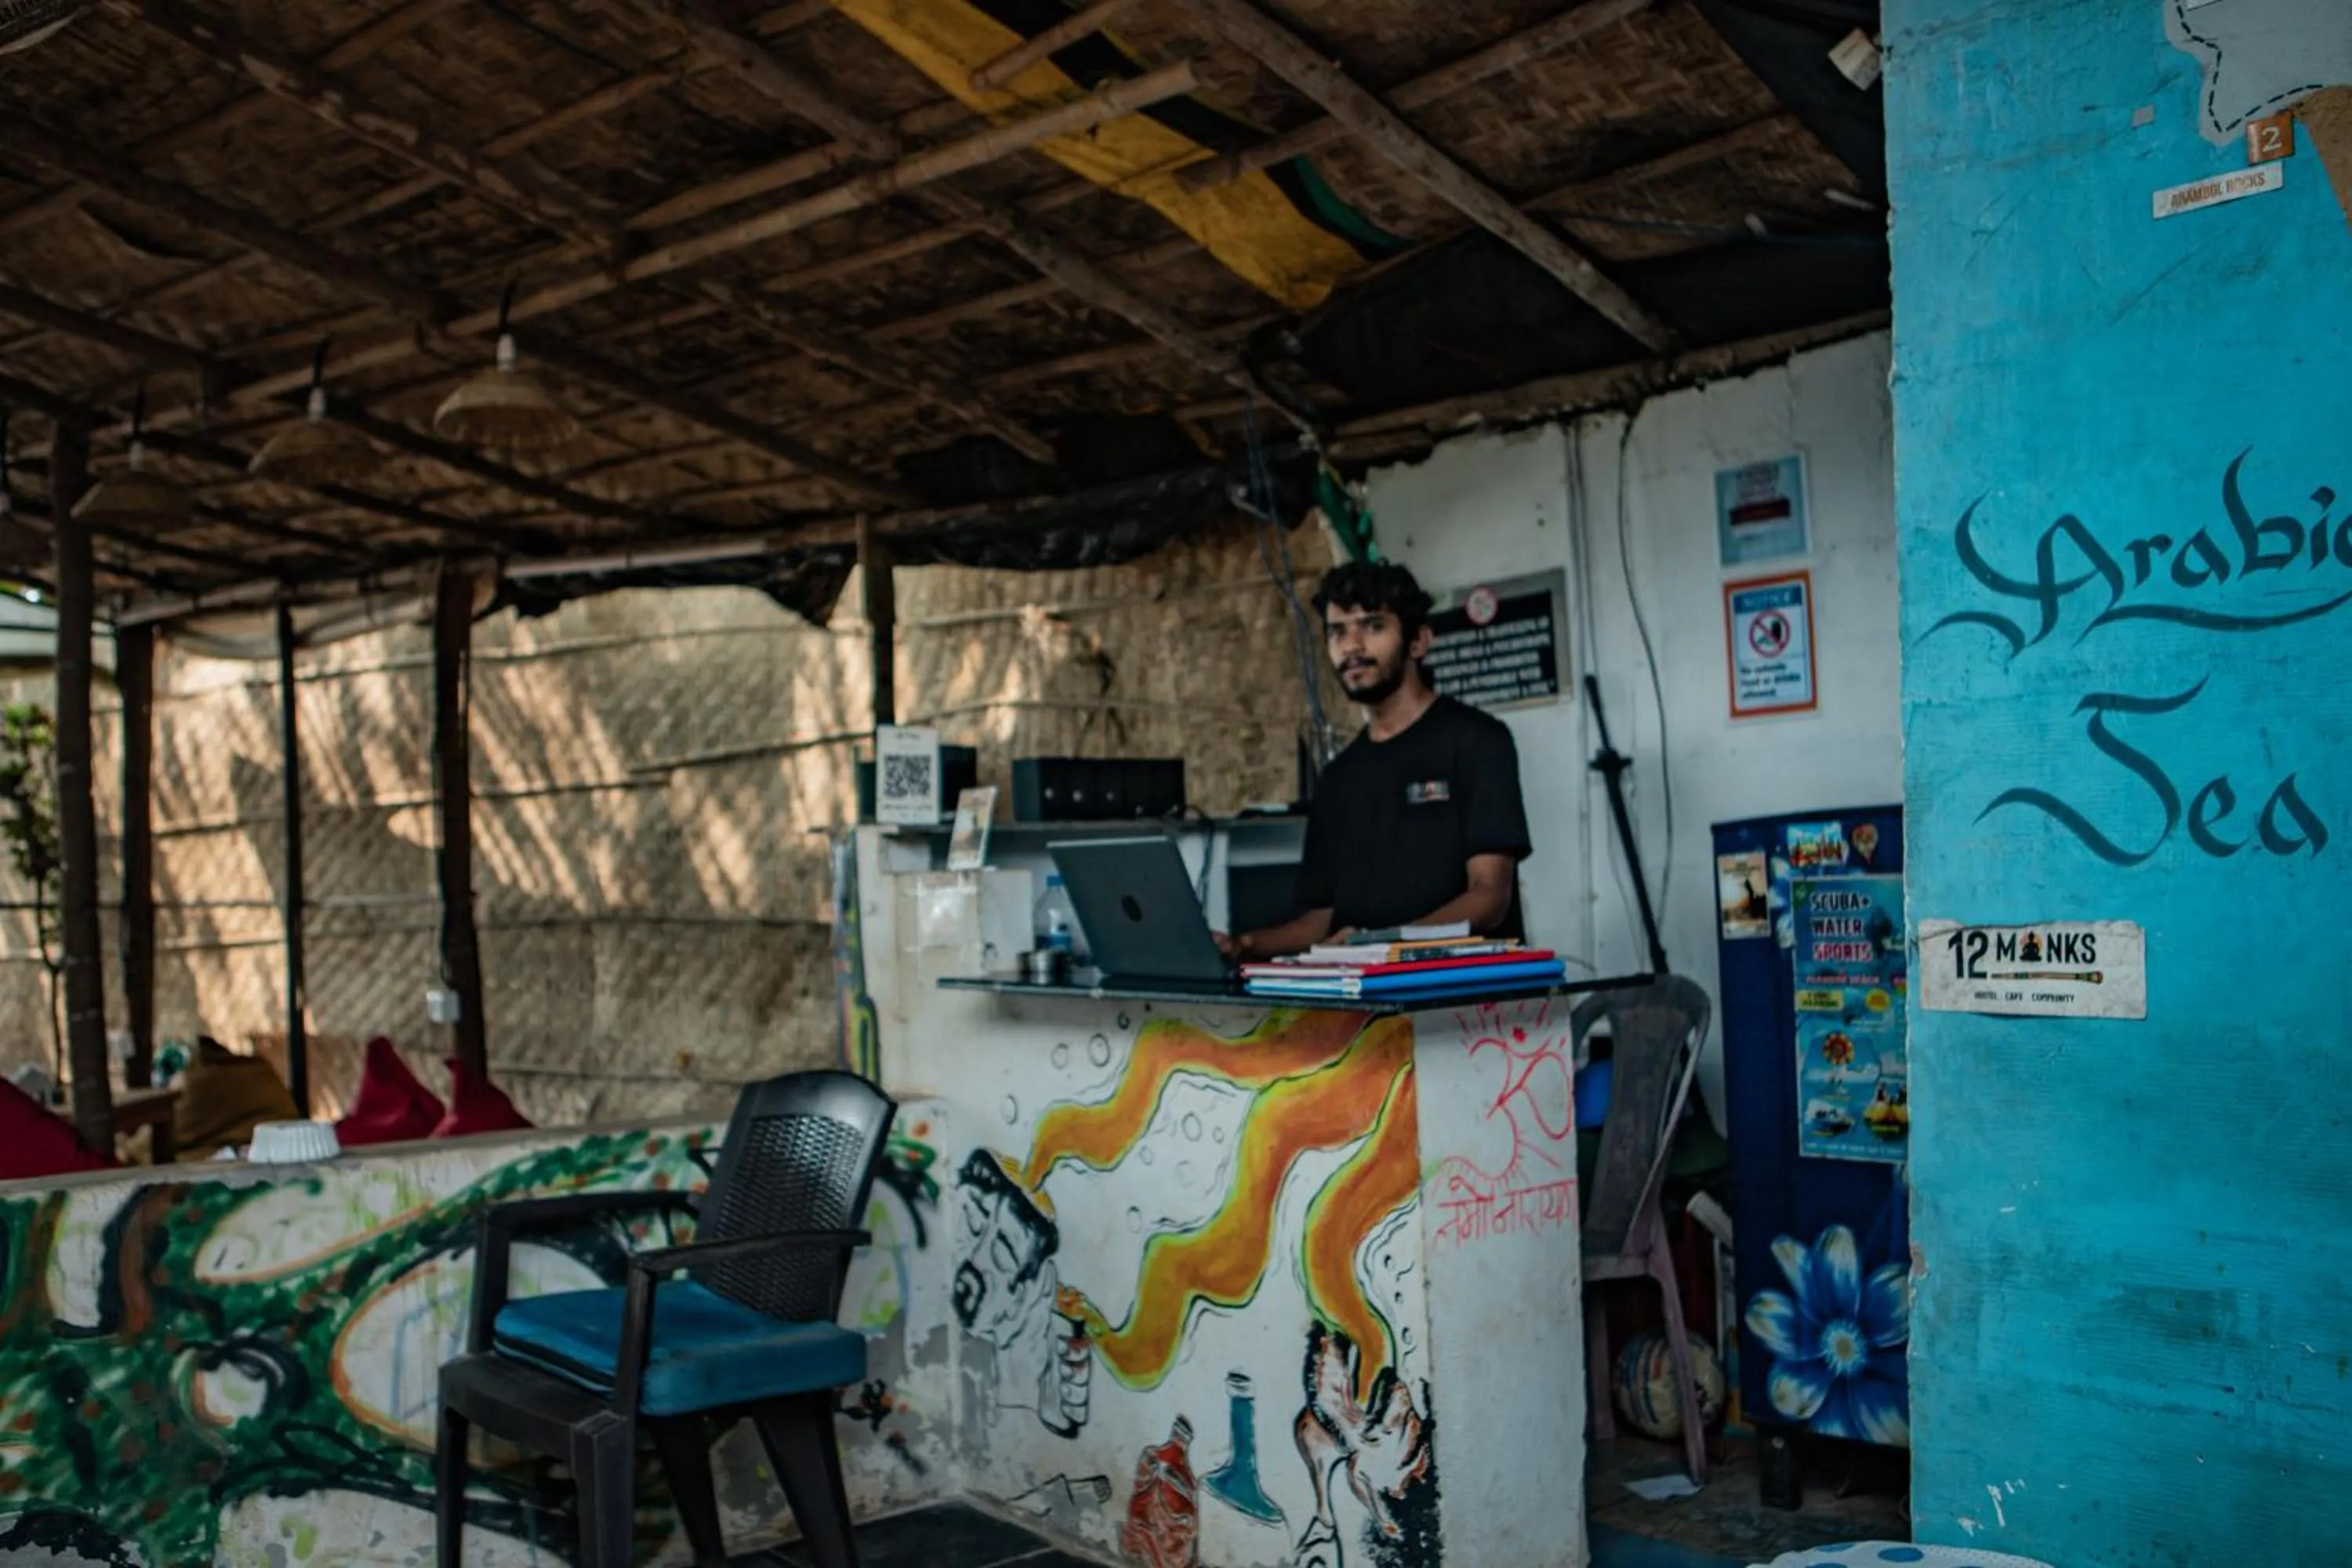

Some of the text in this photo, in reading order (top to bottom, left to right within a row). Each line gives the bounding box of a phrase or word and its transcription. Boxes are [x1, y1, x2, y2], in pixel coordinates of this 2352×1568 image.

[2260, 125, 2282, 153] 2
[2226, 172, 2266, 193] ROCKS
[1973, 673, 2329, 866] Sea
[1811, 916, 1864, 937] WATER
[1813, 942, 1873, 963] SPORTS
[1947, 930, 1989, 979] 12
